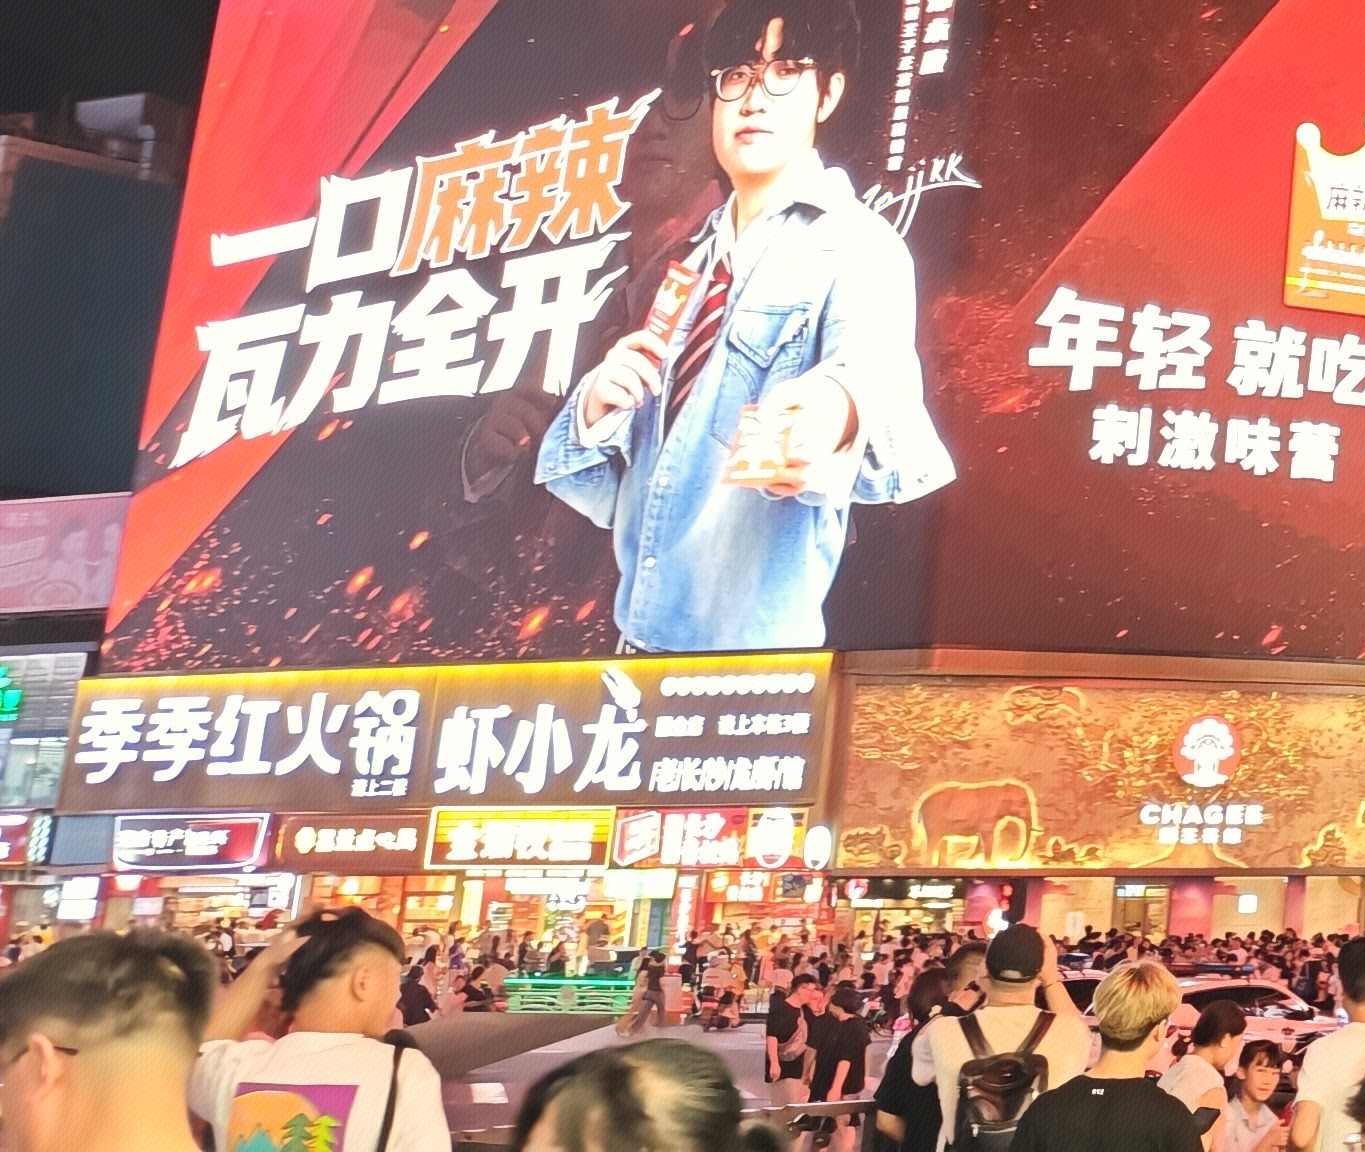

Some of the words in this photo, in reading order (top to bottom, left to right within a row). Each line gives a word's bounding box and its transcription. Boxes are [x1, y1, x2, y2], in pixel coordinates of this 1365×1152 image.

[210, 88, 662, 292] 一口麻辣
[170, 233, 631, 469] 瓦力全开
[1028, 287, 1213, 393] 年轻
[1088, 403, 1341, 484] 刺激味蕾
[74, 689, 421, 784] 季季红火锅
[434, 667, 649, 795] 虾小龙
[1139, 803, 1264, 826] CHAGEE
